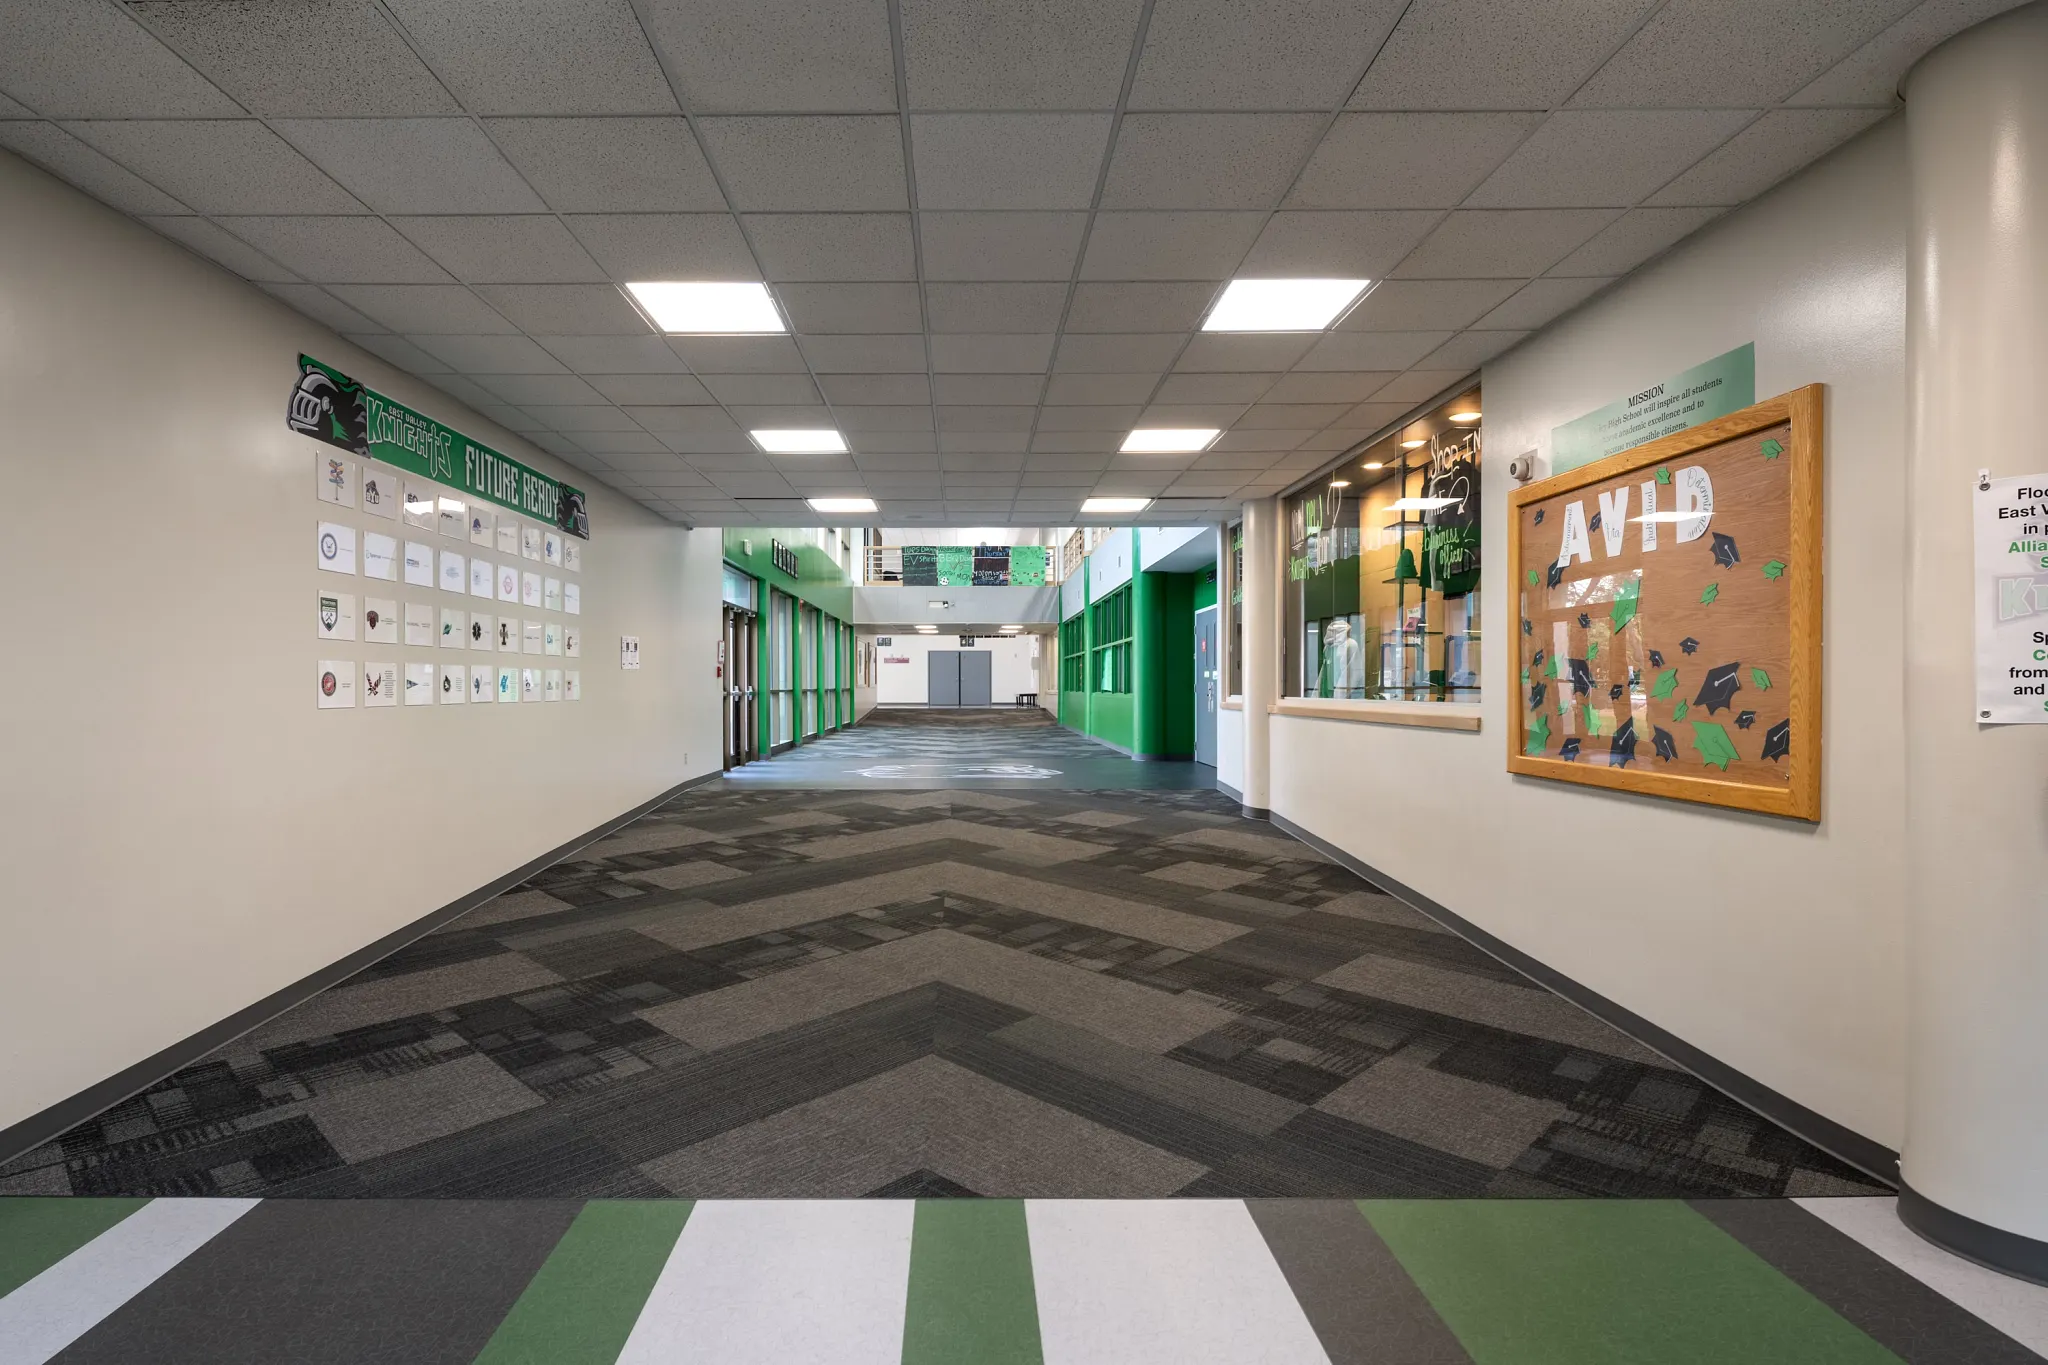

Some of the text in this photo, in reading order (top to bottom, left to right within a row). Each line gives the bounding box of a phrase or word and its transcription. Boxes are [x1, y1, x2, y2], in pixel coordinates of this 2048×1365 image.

[1608, 416, 1622, 429] High
[1622, 408, 1643, 423] School
[1643, 402, 1656, 415] will
[1657, 395, 1681, 411] inspire
[1681, 388, 1691, 400] all
[1692, 377, 1723, 396] students
[1628, 383, 1665, 409] MISSION
[388, 405, 427, 430] EAST VALLEY
[1618, 421, 1647, 438] academic
[1647, 410, 1681, 427] excellence
[1682, 402, 1696, 414] and
[1697, 399, 1705, 409] to
[1625, 430, 1661, 450] responsible
[1661, 421, 1689, 438] citizens.
[1430, 426, 1481, 481] Shop IN
[465, 444, 559, 521] FUTURE READY
[366, 490, 380, 504] BYU
[1998, 505, 2036, 519] East
[2023, 523, 2038, 535] in
[1439, 543, 1464, 580] office
[2032, 649, 2048, 661] C
[2008, 666, 2048, 678] from
[2013, 683, 2045, 695] and
